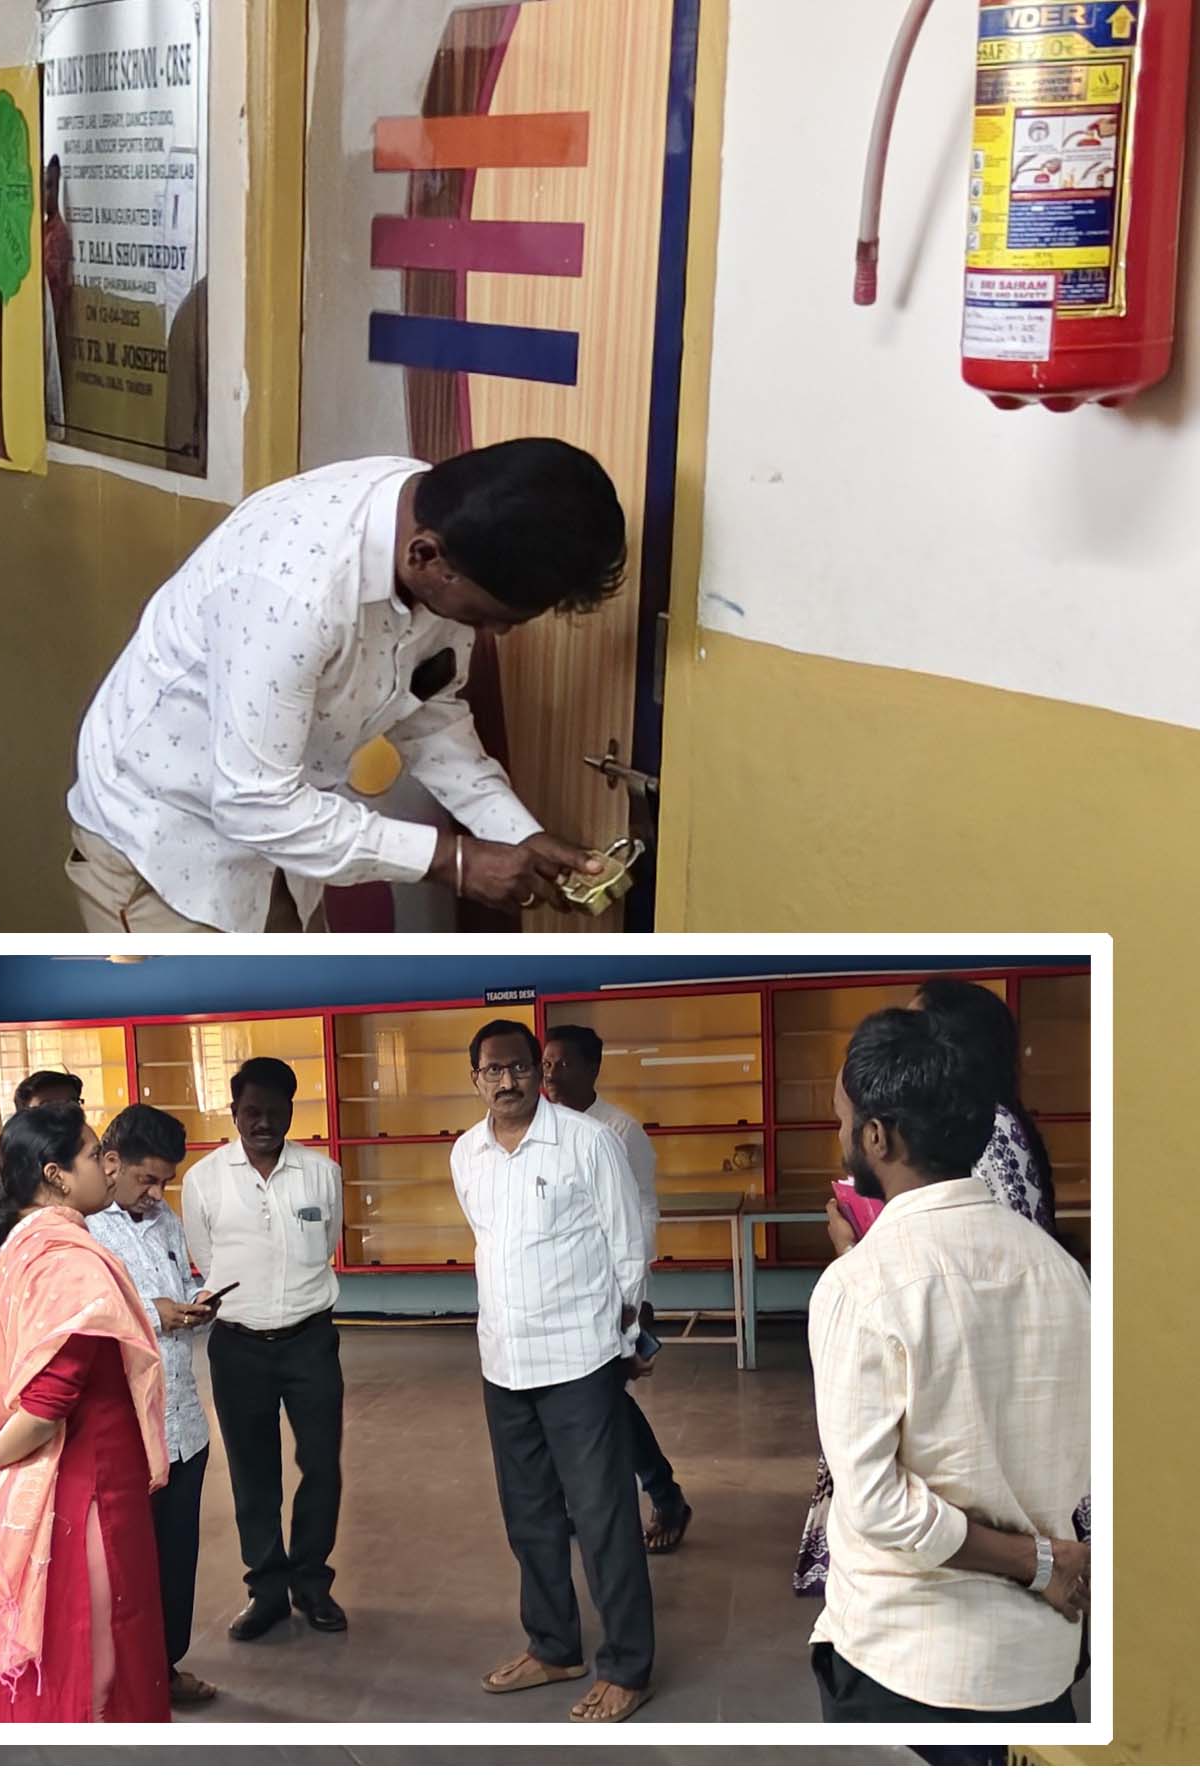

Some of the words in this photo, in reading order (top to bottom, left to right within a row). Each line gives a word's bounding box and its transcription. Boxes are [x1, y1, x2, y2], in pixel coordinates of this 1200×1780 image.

[120, 47, 158, 90] SCHOOL
[166, 43, 191, 87] CBSE
[88, 240, 113, 265] BALA
[115, 242, 187, 270] SHOWREDDY
[998, 279, 1047, 290] SAIRAM
[121, 344, 168, 374] JOSEPH
[486, 990, 518, 1001] TEACHERS
[519, 989, 536, 999] DESK
